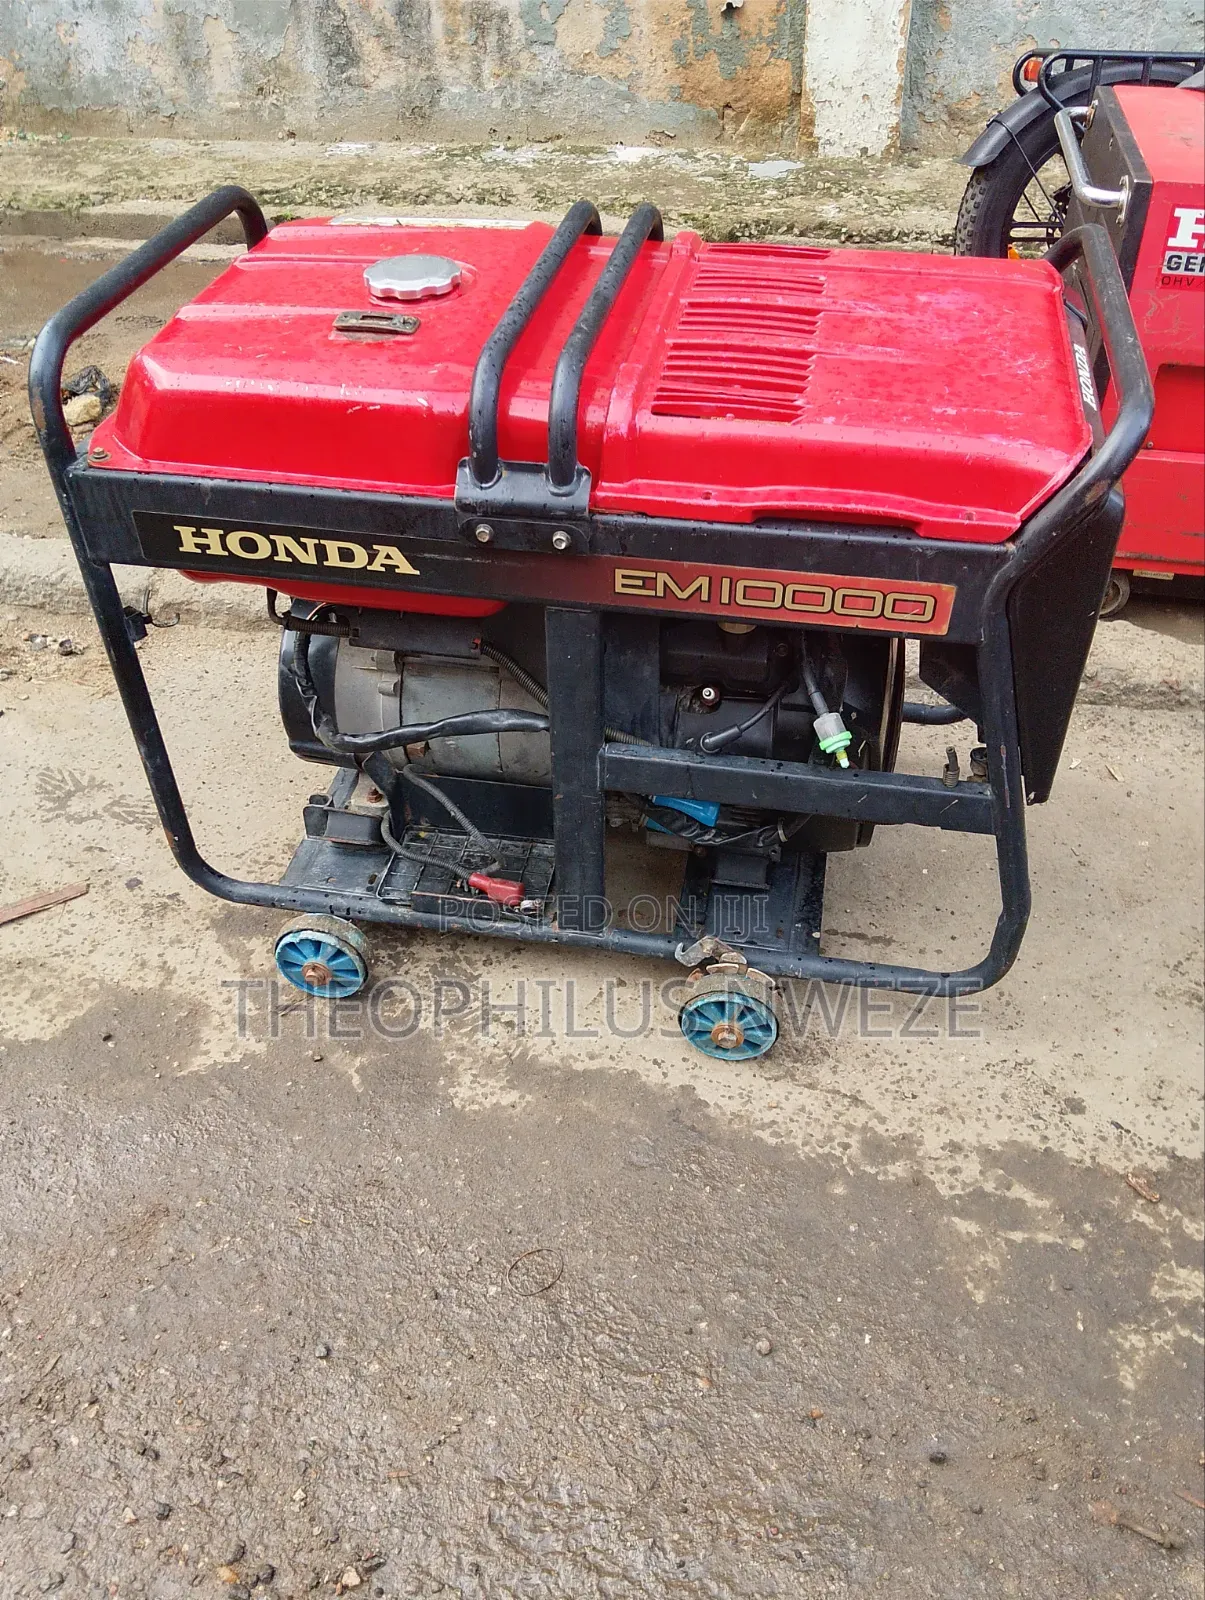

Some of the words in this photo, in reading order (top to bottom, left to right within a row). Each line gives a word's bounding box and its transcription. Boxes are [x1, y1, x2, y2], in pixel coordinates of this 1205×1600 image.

[1073, 343, 1097, 411] HONDA
[173, 525, 421, 576] HONDA
[614, 568, 937, 623] EM10000
